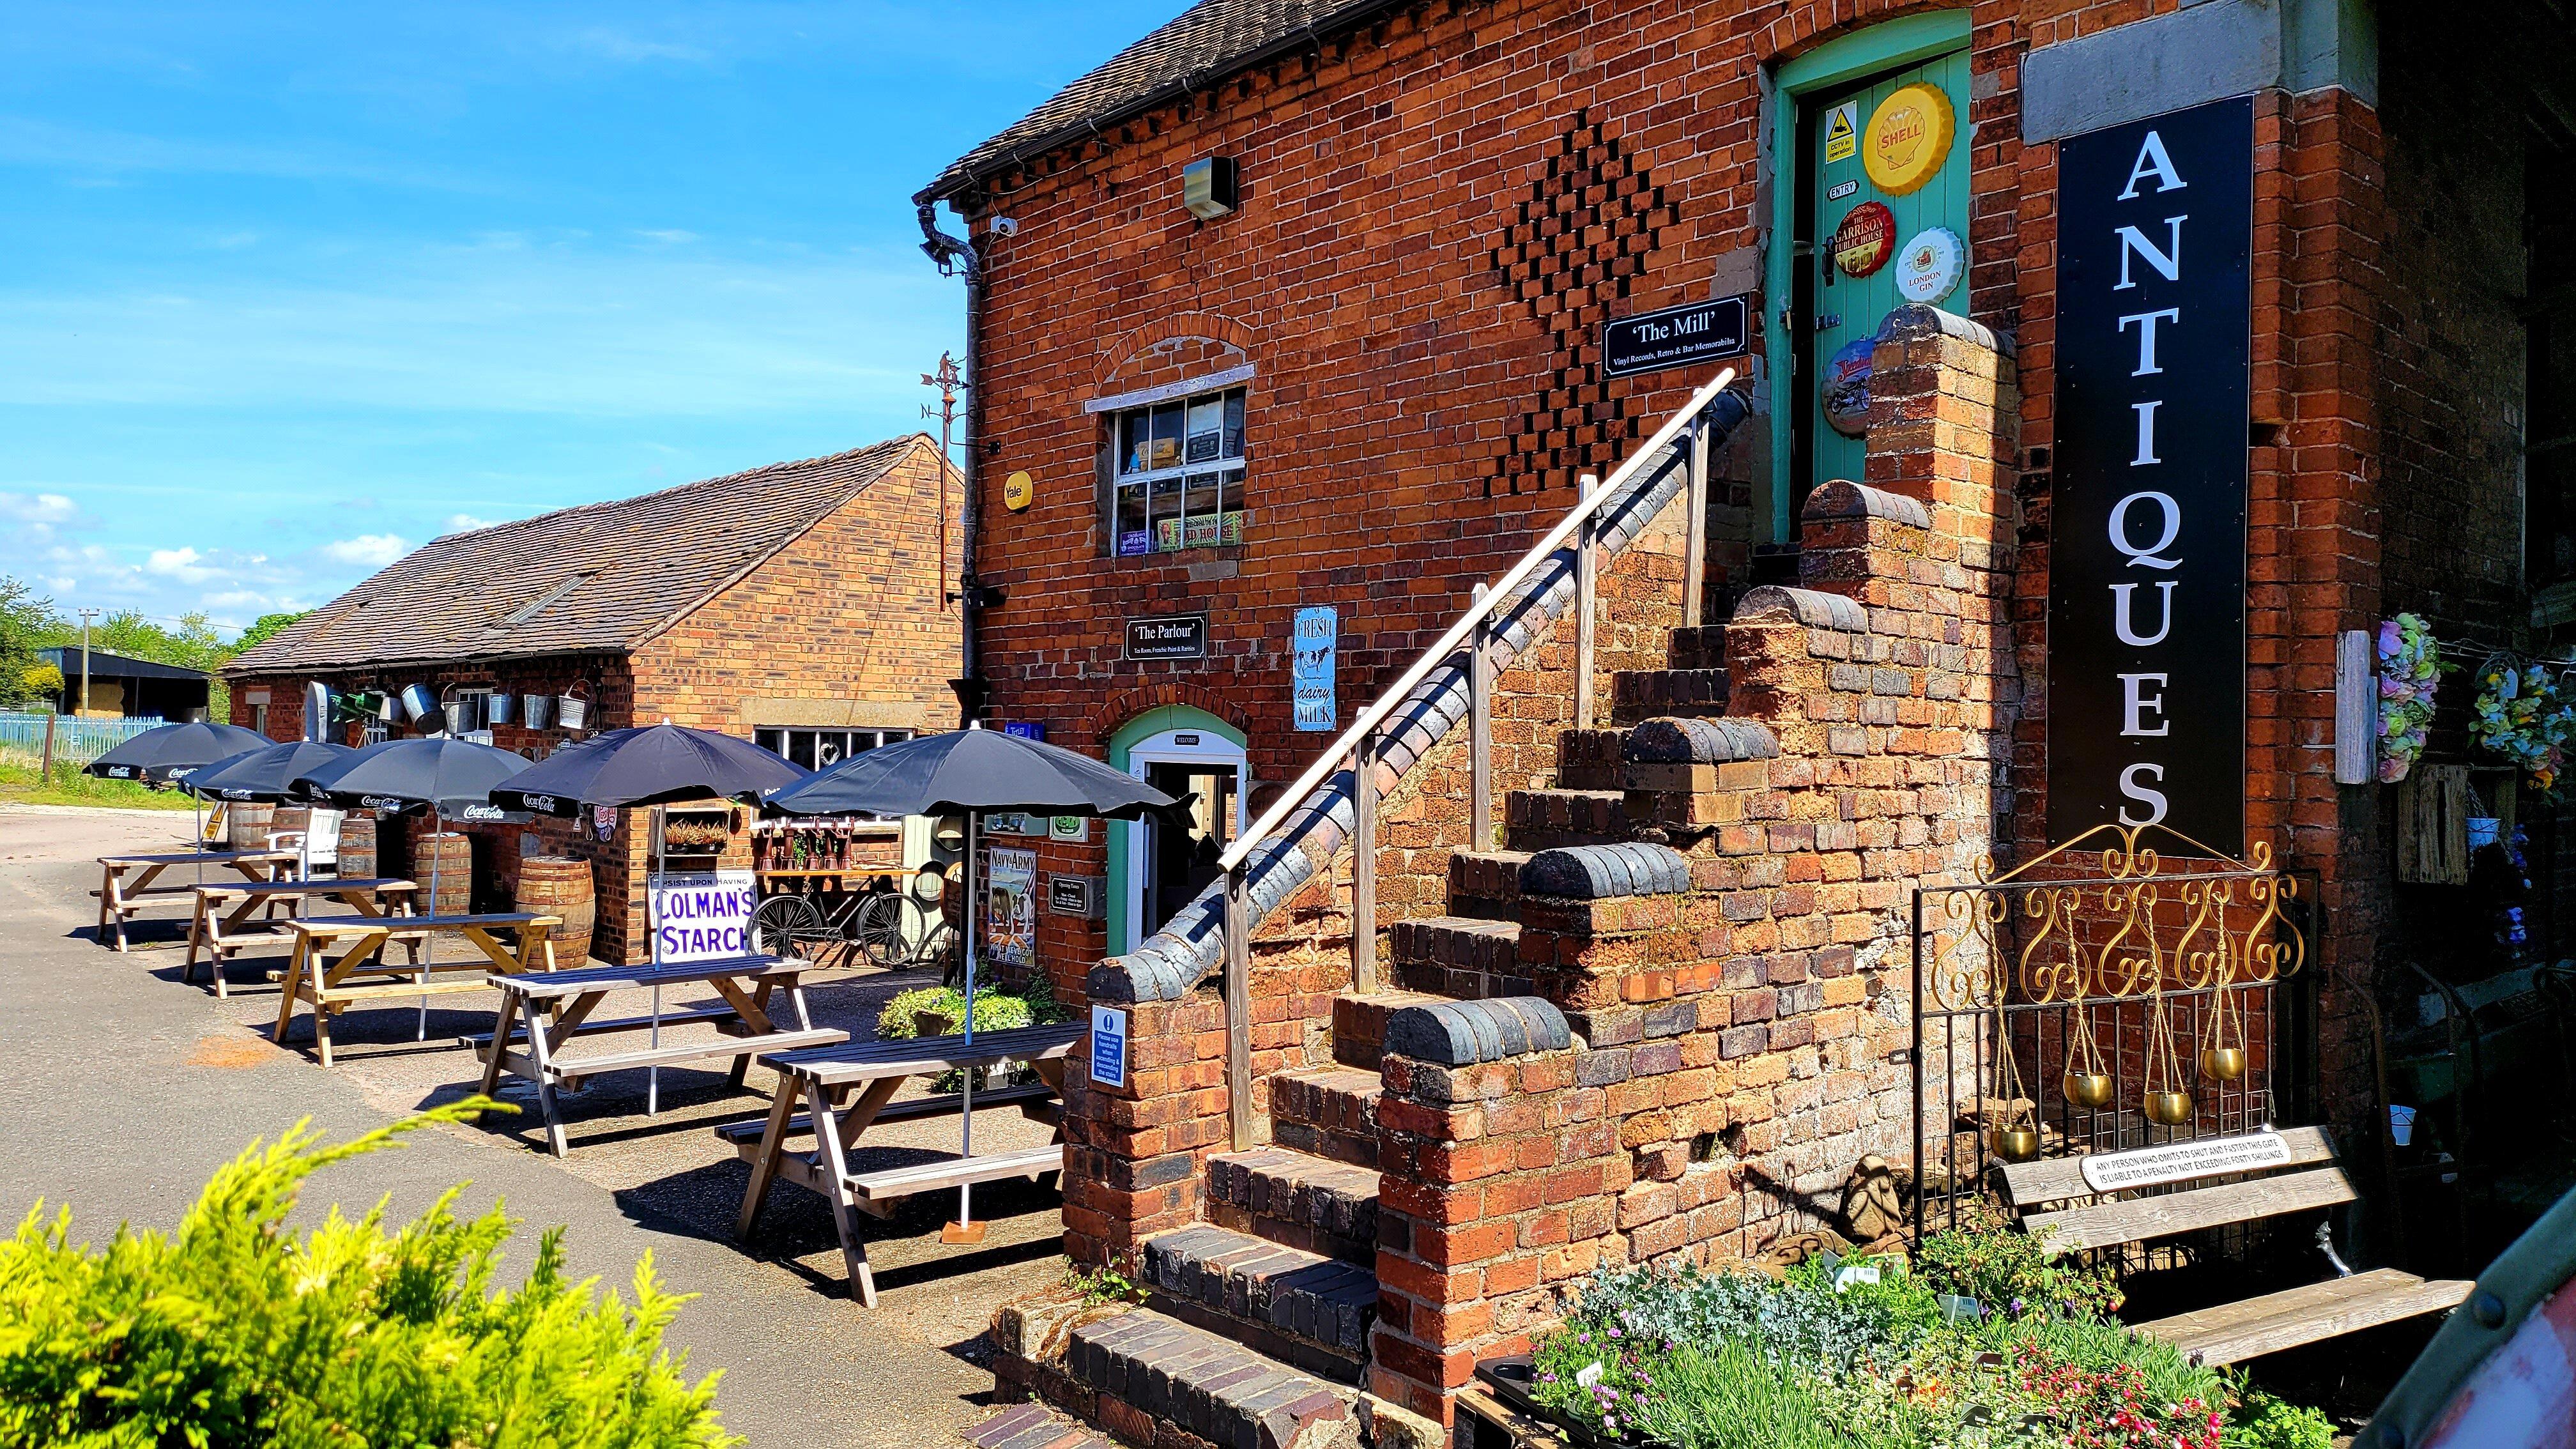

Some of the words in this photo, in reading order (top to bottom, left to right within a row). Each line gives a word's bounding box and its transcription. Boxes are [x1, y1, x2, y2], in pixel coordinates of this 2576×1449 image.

[1881, 123, 1921, 149] SHELL
[1829, 146, 1852, 158] operation
[1830, 141, 1844, 151] CCTV
[1831, 182, 1854, 198] ENTRY
[1854, 215, 1864, 225] THE
[1835, 217, 1883, 243] GARRISON
[1835, 237, 1860, 253] PUBLIC
[1860, 229, 1883, 245] HOUSE
[1908, 270, 1942, 287] LONDON
[1919, 282, 1934, 292] GIN
[1613, 355, 1629, 367] Vinyl
[1630, 352, 1656, 364] Records,
[1657, 349, 1674, 358] Retro
[1695, 337, 1735, 351] Memorabilia
[2108, 130, 2188, 827] ANTIQUES
[1006, 485, 1022, 499] Yale
[1298, 618, 1332, 638] FRESH
[1298, 683, 1331, 704] dairy
[1298, 706, 1332, 723] MILK
[655, 887, 756, 920] COLMAN'S
[1011, 955, 1026, 964] HOLD
[1022, 949, 1032, 957] GOT
[1097, 1032, 1110, 1041] Please
[1098, 1040, 1117, 1050] handrails
[2096, 1161, 2110, 1172] ANY
[2111, 1157, 2140, 1169] PERSON
[2140, 1154, 2158, 1165] WHO
[2158, 1151, 2181, 1162] OMITS
[2181, 1150, 2190, 1159] TO
[2191, 1147, 2208, 1158] SHUT
[2209, 1145, 2224, 1156] AND
[2223, 1142, 2248, 1153] FASTEN
[2248, 1140, 2263, 1149] THIS
[2262, 1138, 2279, 1148] GATE
[2099, 1174, 2108, 1184] IS
[2107, 1170, 2132, 1183] LIABLE
[2131, 1169, 2142, 1178] TO
[2143, 1169, 2149, 1177] A
[2148, 1164, 2178, 1177] PENALTY
[2178, 1162, 2193, 1172] NOT
[2193, 1156, 2232, 1170] EXCEEDING
[2231, 1154, 2251, 1164] FORTY
[2252, 1149, 2284, 1162] SHILLINGS
